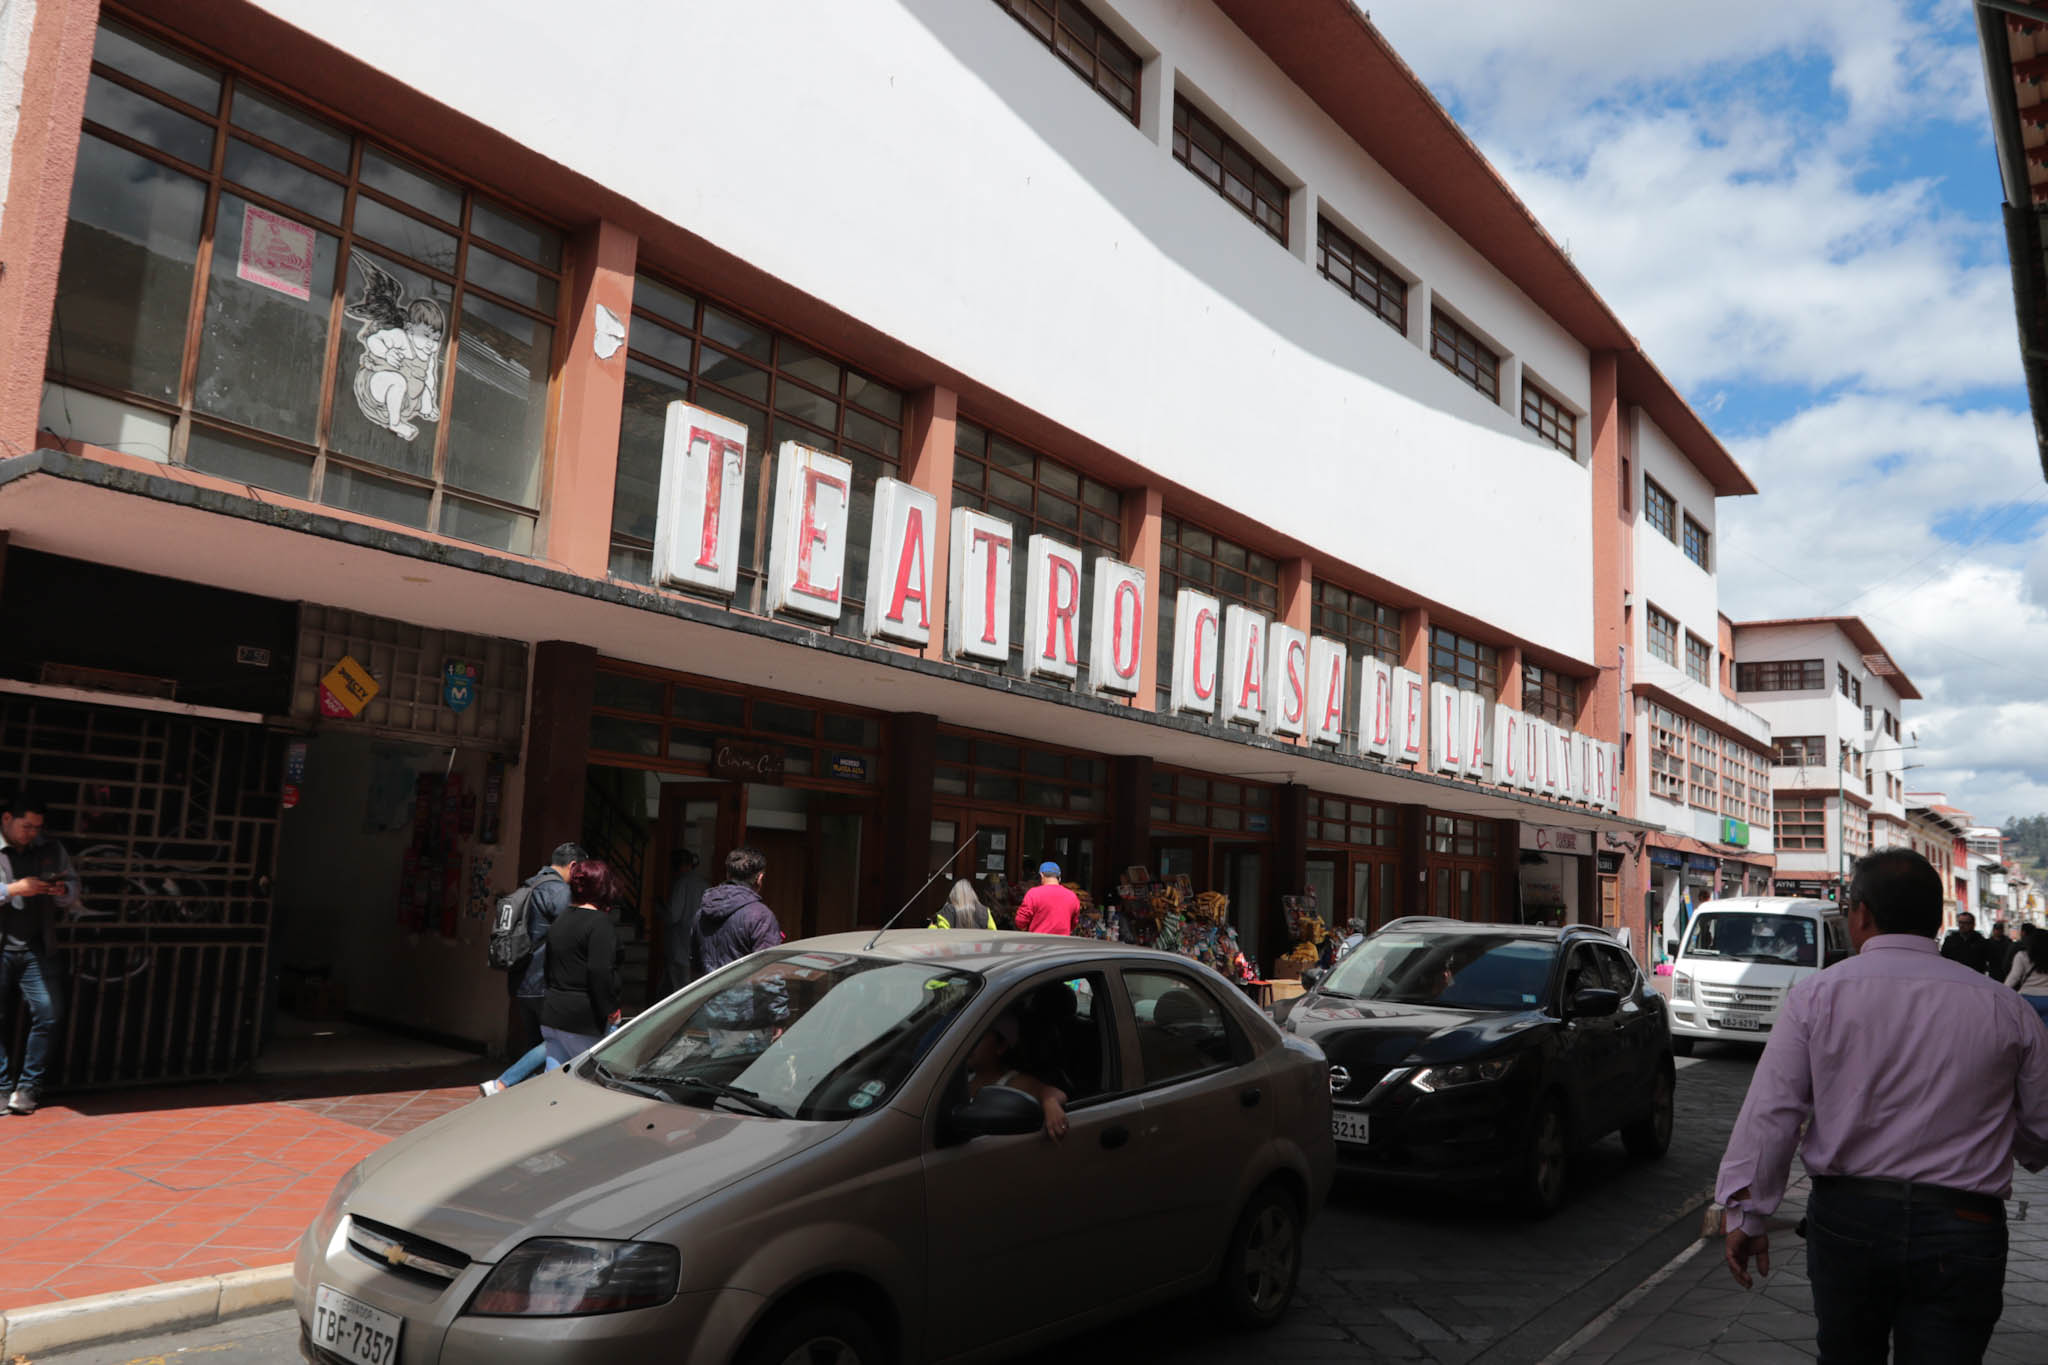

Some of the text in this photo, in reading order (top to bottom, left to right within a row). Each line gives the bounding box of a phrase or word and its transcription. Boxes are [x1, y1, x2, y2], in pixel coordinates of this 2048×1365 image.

[687, 425, 1619, 803] TEATRO CASA DE LA CULTURA
[1776, 880, 1796, 888] AYNI
[317, 1306, 394, 1365] TBF-7357
